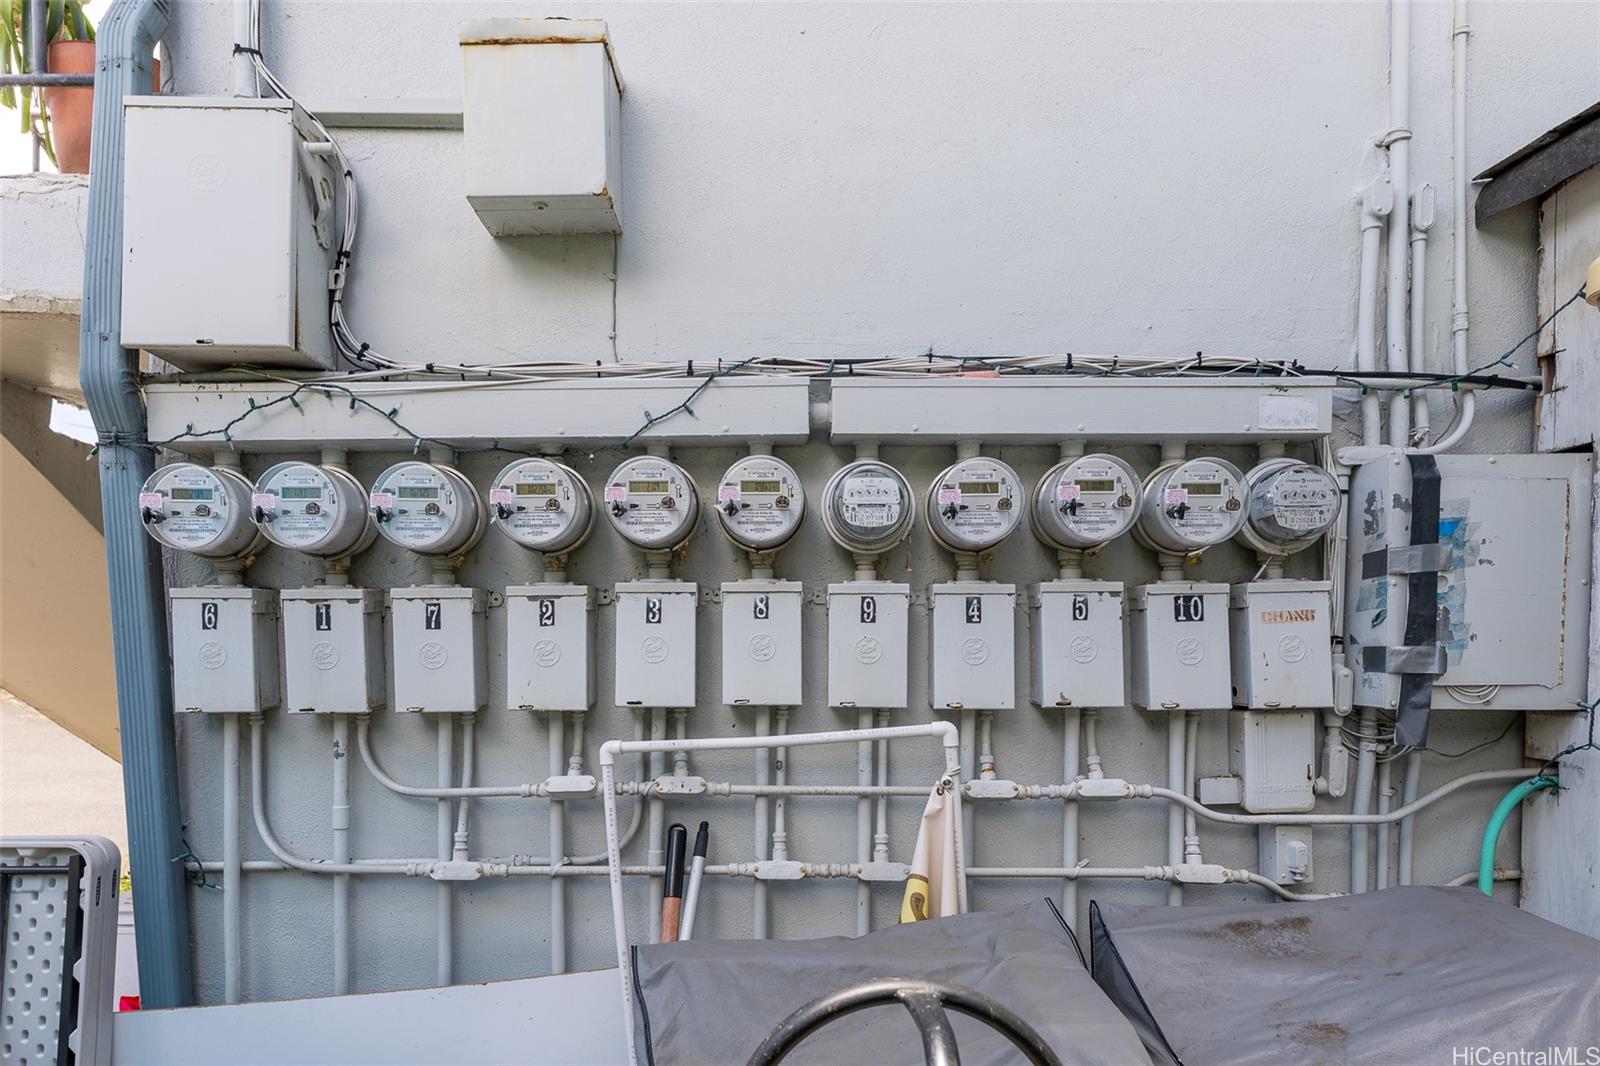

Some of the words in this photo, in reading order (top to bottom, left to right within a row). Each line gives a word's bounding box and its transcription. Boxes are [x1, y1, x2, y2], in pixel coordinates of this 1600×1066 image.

[203, 603, 216, 628] 6
[319, 605, 328, 629] 1
[427, 604, 439, 629] 7
[541, 601, 553, 626] 2
[648, 598, 660, 623] 3
[755, 594, 767, 618] 8
[862, 597, 874, 622] 9
[967, 598, 980, 622] 4
[1074, 594, 1087, 620] 5
[1176, 596, 1202, 621] 10
